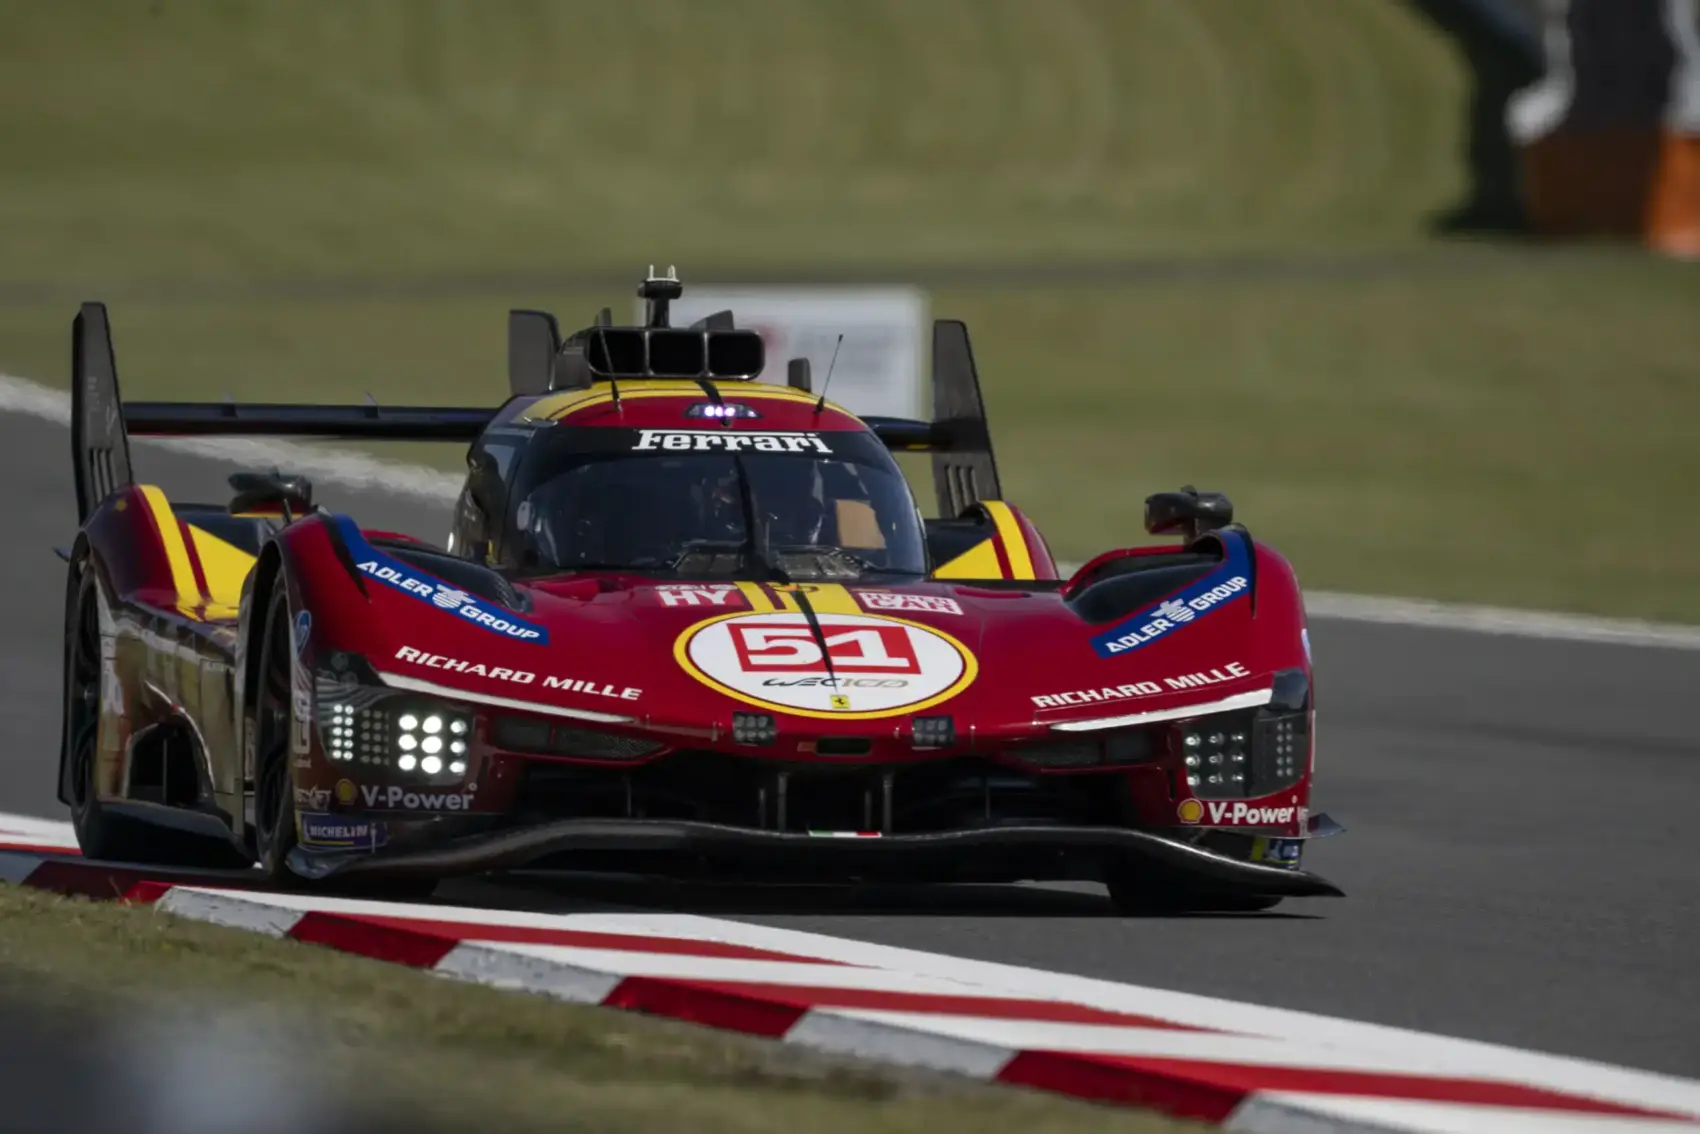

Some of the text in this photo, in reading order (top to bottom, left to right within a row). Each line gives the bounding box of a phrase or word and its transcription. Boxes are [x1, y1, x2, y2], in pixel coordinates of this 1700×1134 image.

[632, 430, 833, 453] Ferrari
[356, 561, 540, 640] ADLER GROUP
[659, 590, 729, 606] HY
[1105, 575, 1248, 653] ADLER GROUP
[739, 628, 911, 668] 51
[395, 645, 643, 700] RICHARD MILLE
[1030, 661, 1251, 708] RICHARD MILLE
[361, 785, 475, 810] V-Power
[1208, 801, 1294, 825] V-Power
[309, 824, 369, 838] MICHELIN
